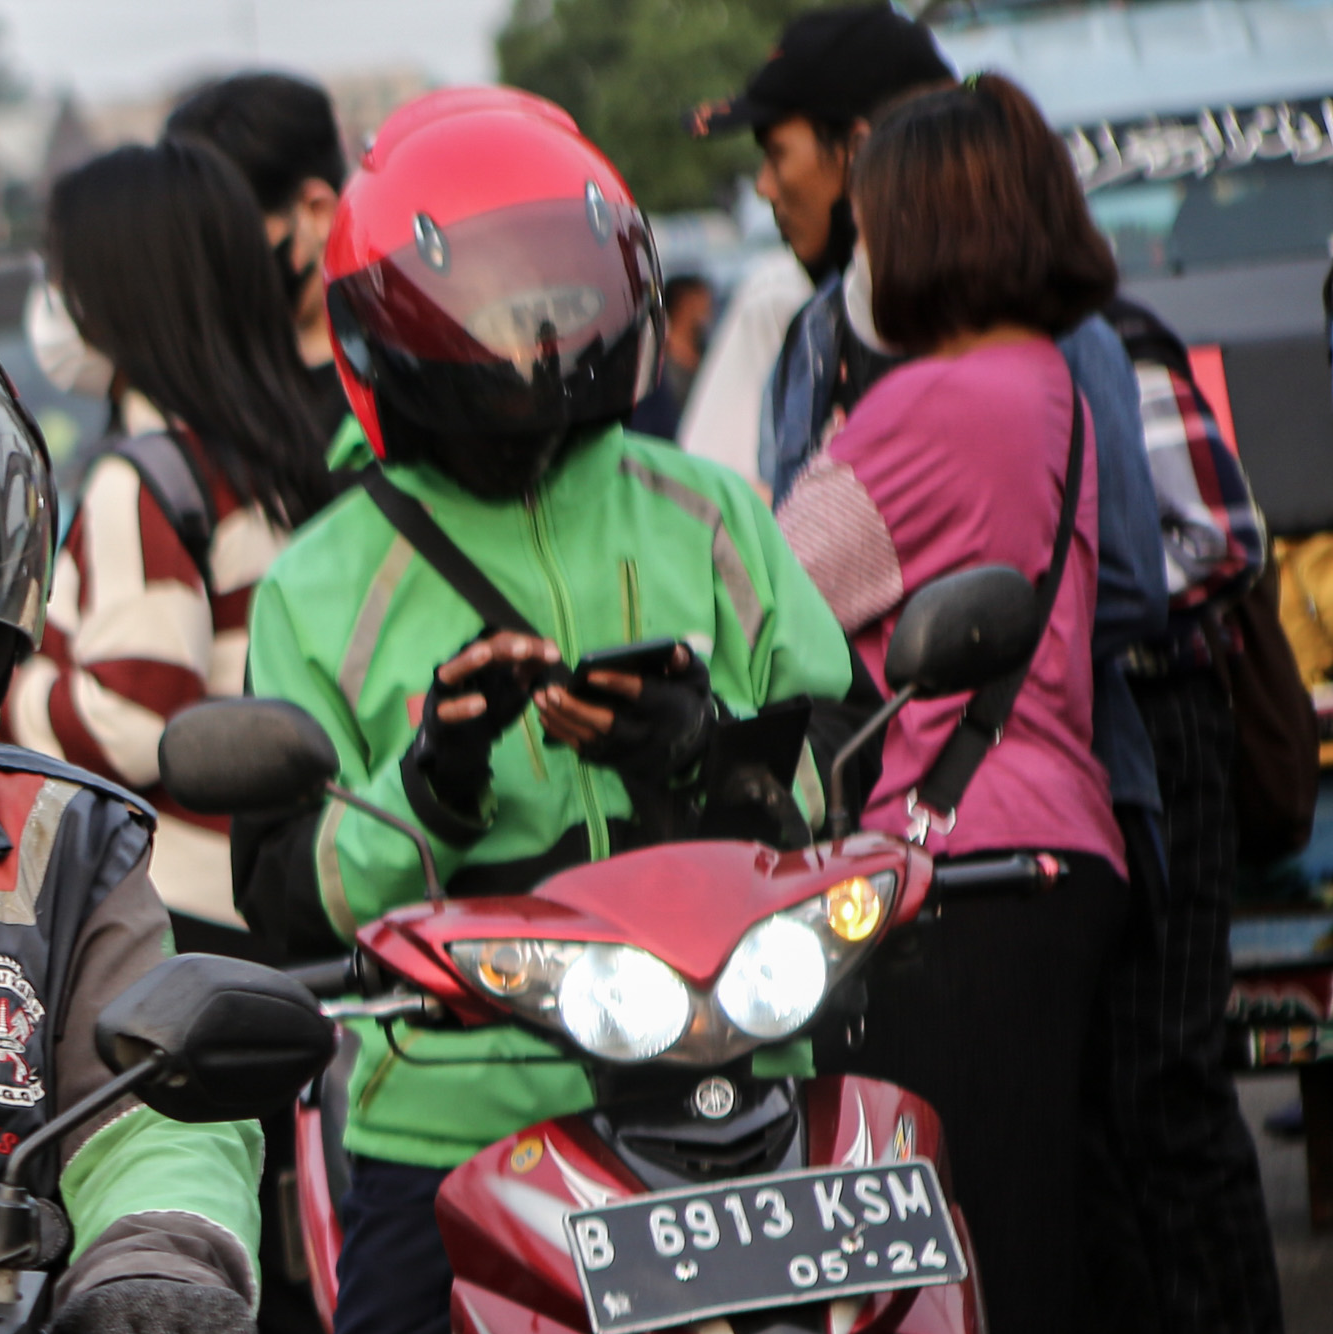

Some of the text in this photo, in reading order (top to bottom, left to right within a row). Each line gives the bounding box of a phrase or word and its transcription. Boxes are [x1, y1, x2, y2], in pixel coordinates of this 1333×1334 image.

[575, 1168, 932, 1271] B 6913 KSM
